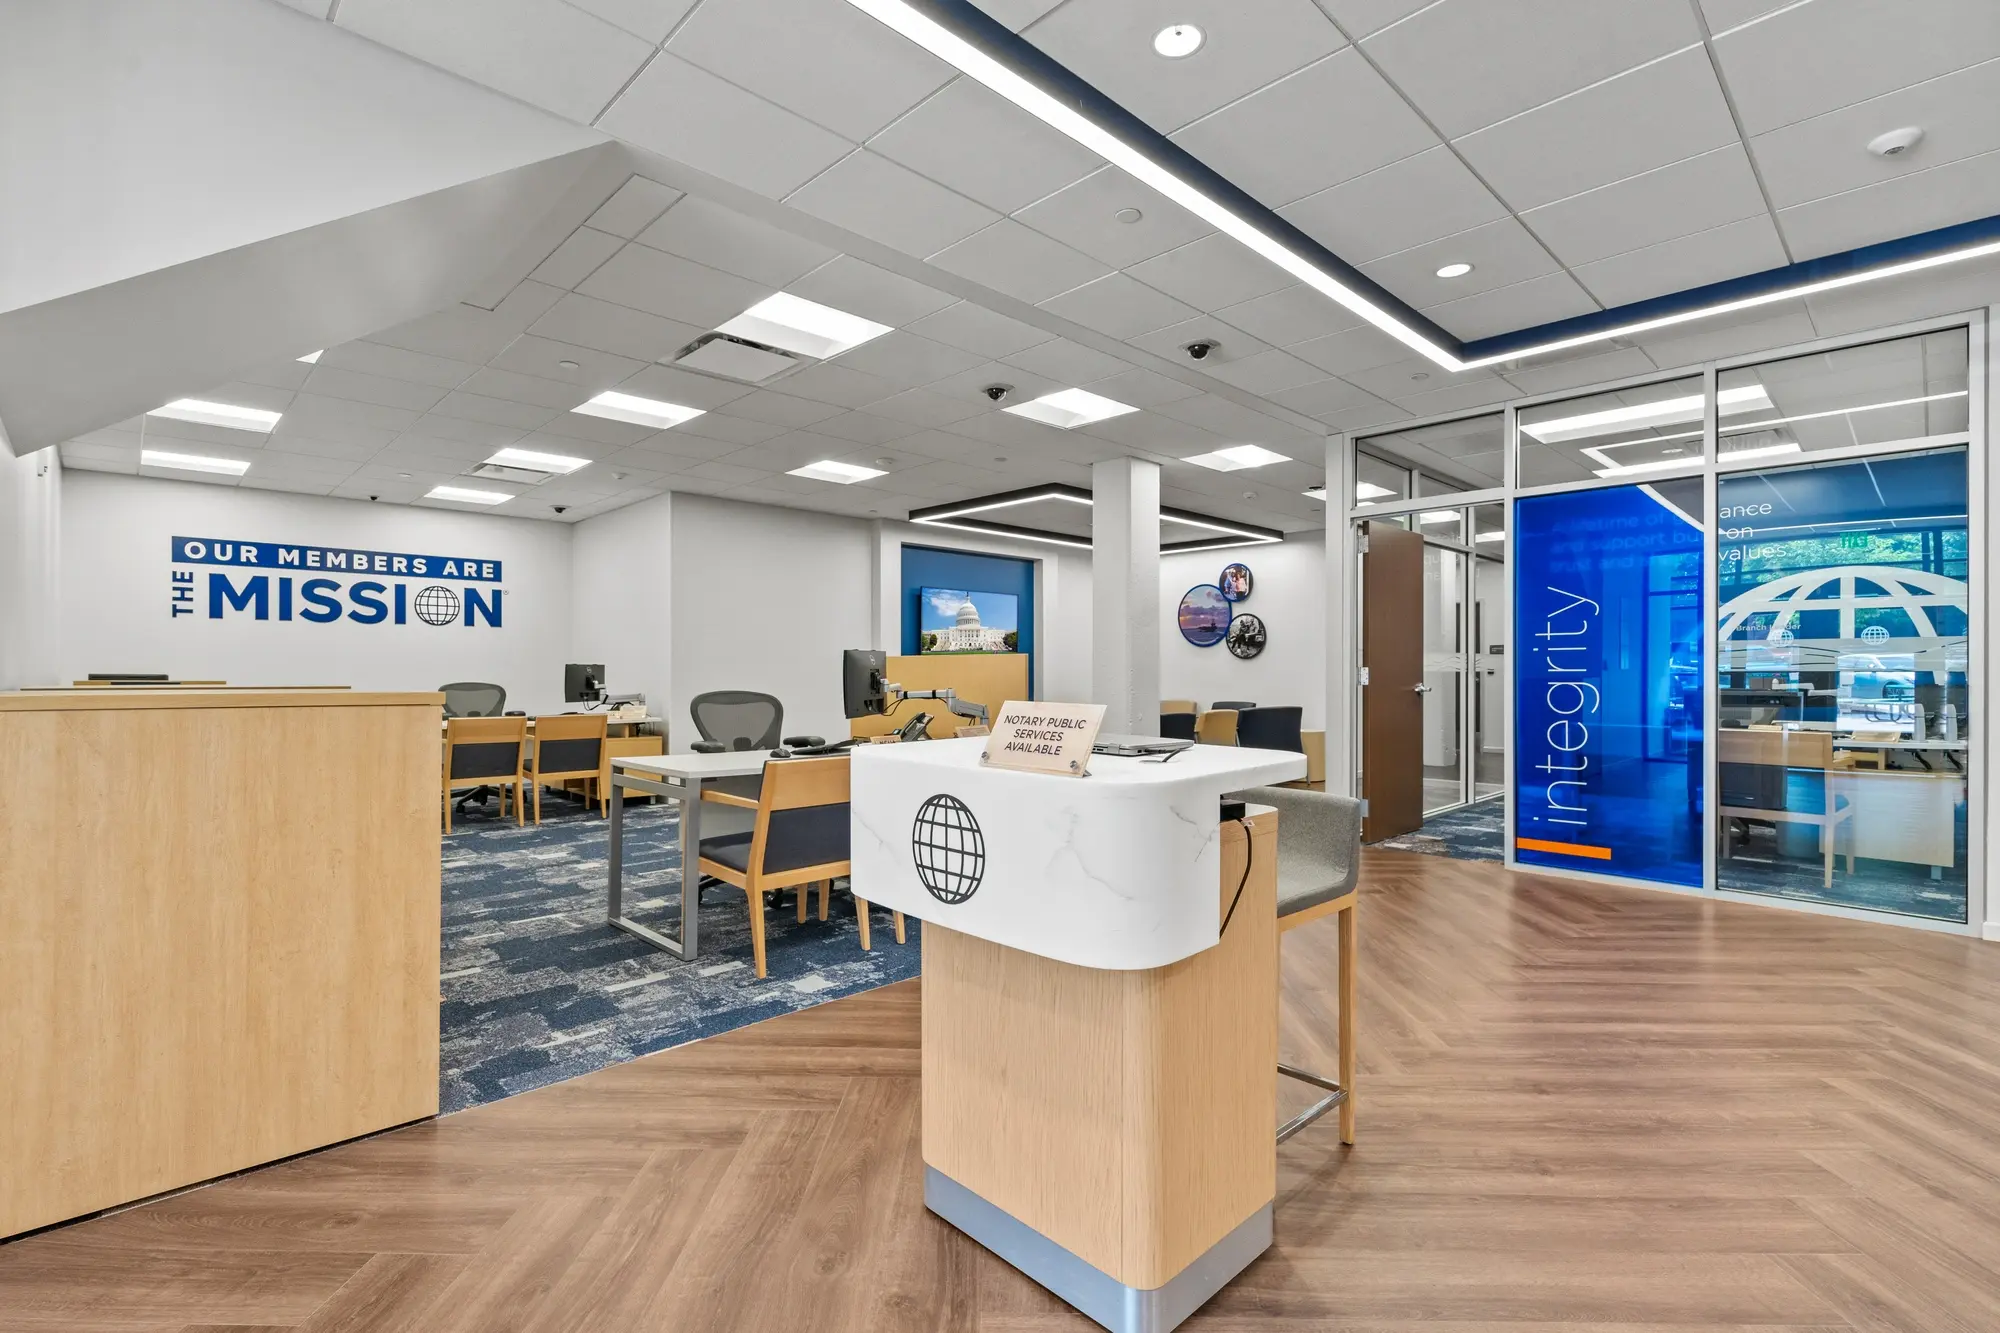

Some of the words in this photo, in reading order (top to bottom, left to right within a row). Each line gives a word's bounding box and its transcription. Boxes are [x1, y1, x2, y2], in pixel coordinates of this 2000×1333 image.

[1719, 503, 1772, 518] ance
[1726, 526, 1753, 539] on
[184, 541, 258, 563] OUR
[278, 548, 428, 574] MEMBERS
[443, 560, 495, 578] ARE
[172, 570, 194, 618] THE
[1533, 586, 1600, 825] integrity
[1003, 715, 1046, 726] NOTARY
[1046, 717, 1087, 729] PUBLIC
[1013, 728, 1064, 742] SERVICES
[1003, 741, 1062, 756] AVAILABLE
